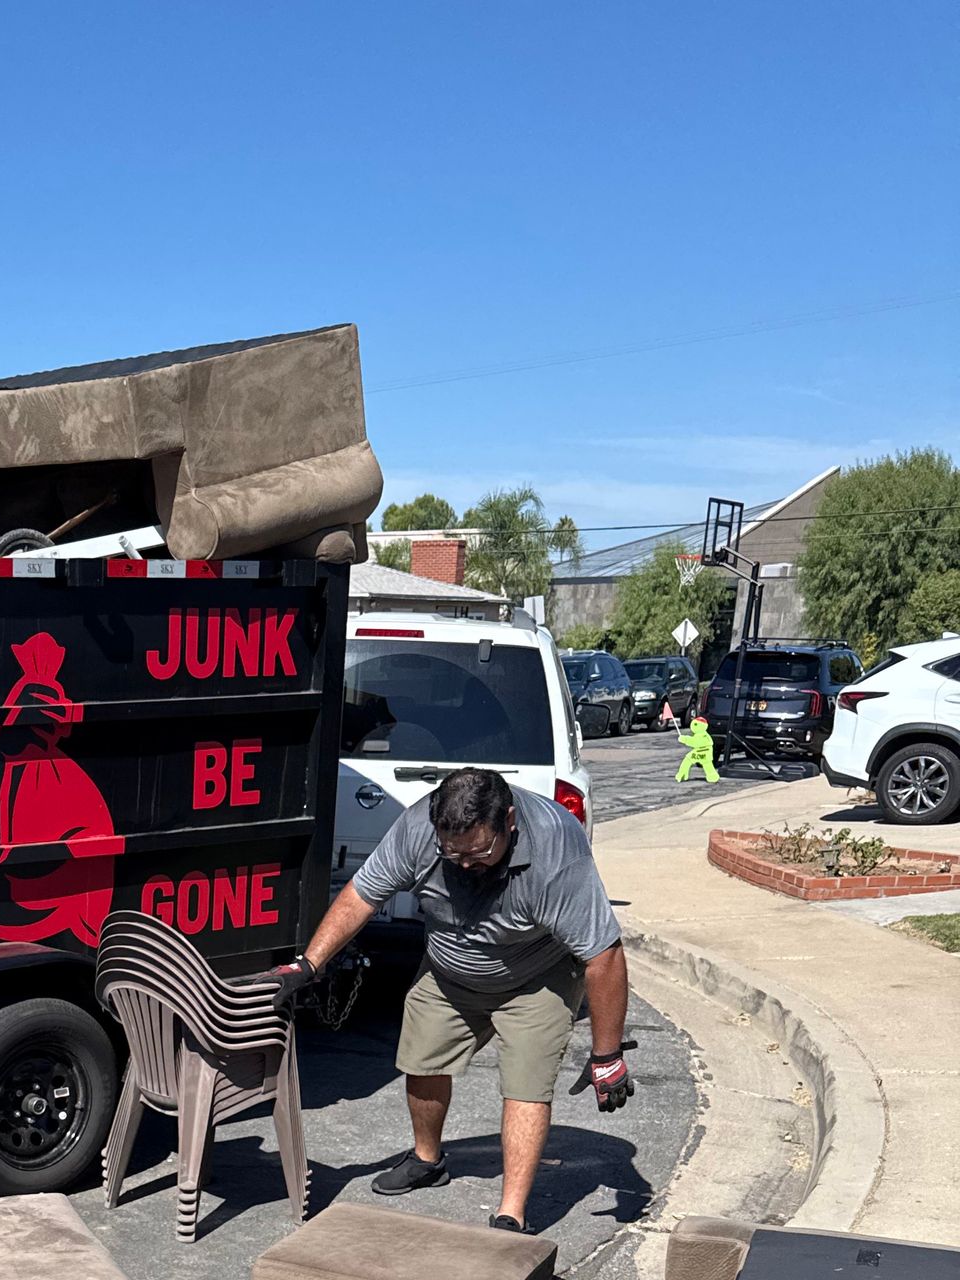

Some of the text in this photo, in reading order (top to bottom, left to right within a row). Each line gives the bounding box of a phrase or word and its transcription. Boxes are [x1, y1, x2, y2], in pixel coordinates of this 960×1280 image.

[27, 563, 42, 571] SKY
[146, 607, 300, 680] JUNK
[193, 738, 262, 810] BE
[141, 862, 281, 936] GONE
